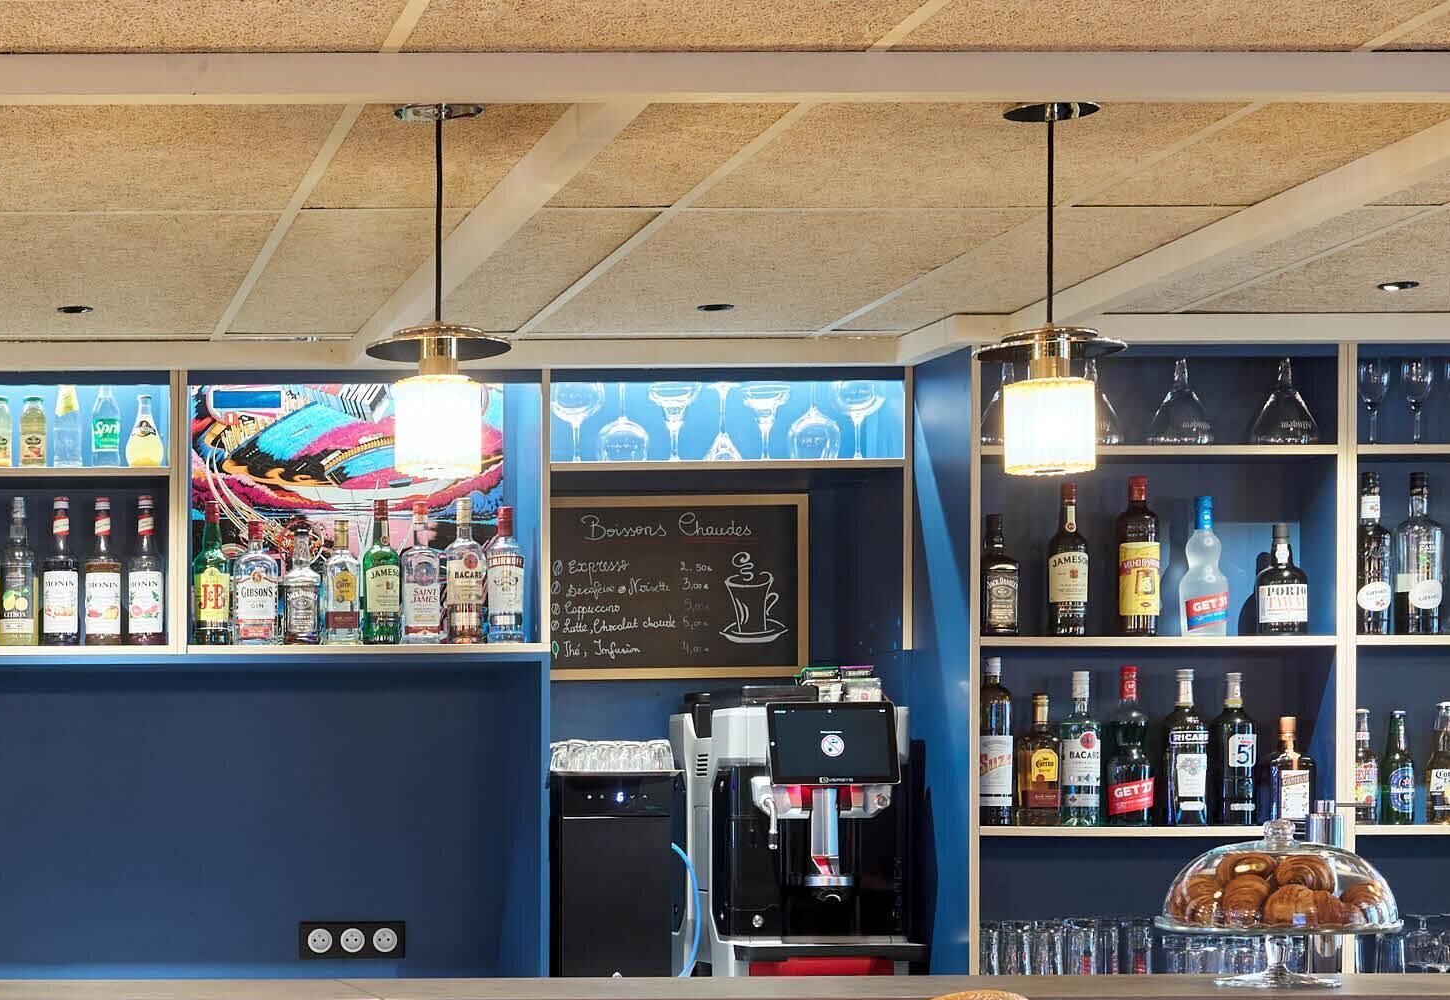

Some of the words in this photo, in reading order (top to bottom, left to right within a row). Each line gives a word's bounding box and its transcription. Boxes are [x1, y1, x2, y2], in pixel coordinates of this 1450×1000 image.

[580, 514, 667, 541] Boissons
[678, 511, 752, 537] Chaudes
[1052, 554, 1088, 568] JAMESO
[370, 567, 399, 580] JAMESO
[454, 571, 483, 580] BACARD
[568, 559, 630, 584] Expresso
[198, 583, 226, 610] J&B
[413, 588, 437, 596] SAINT
[412, 596, 438, 604] JAMES
[1192, 600, 1217, 612] GET
[564, 600, 620, 621] Cappuccino
[593, 617, 639, 634] Chocolat
[1070, 750, 1100, 759] BACAR
[1236, 743, 1254, 765] 51
[616, 791, 624, 802] 6
[1114, 785, 1140, 798] GET
